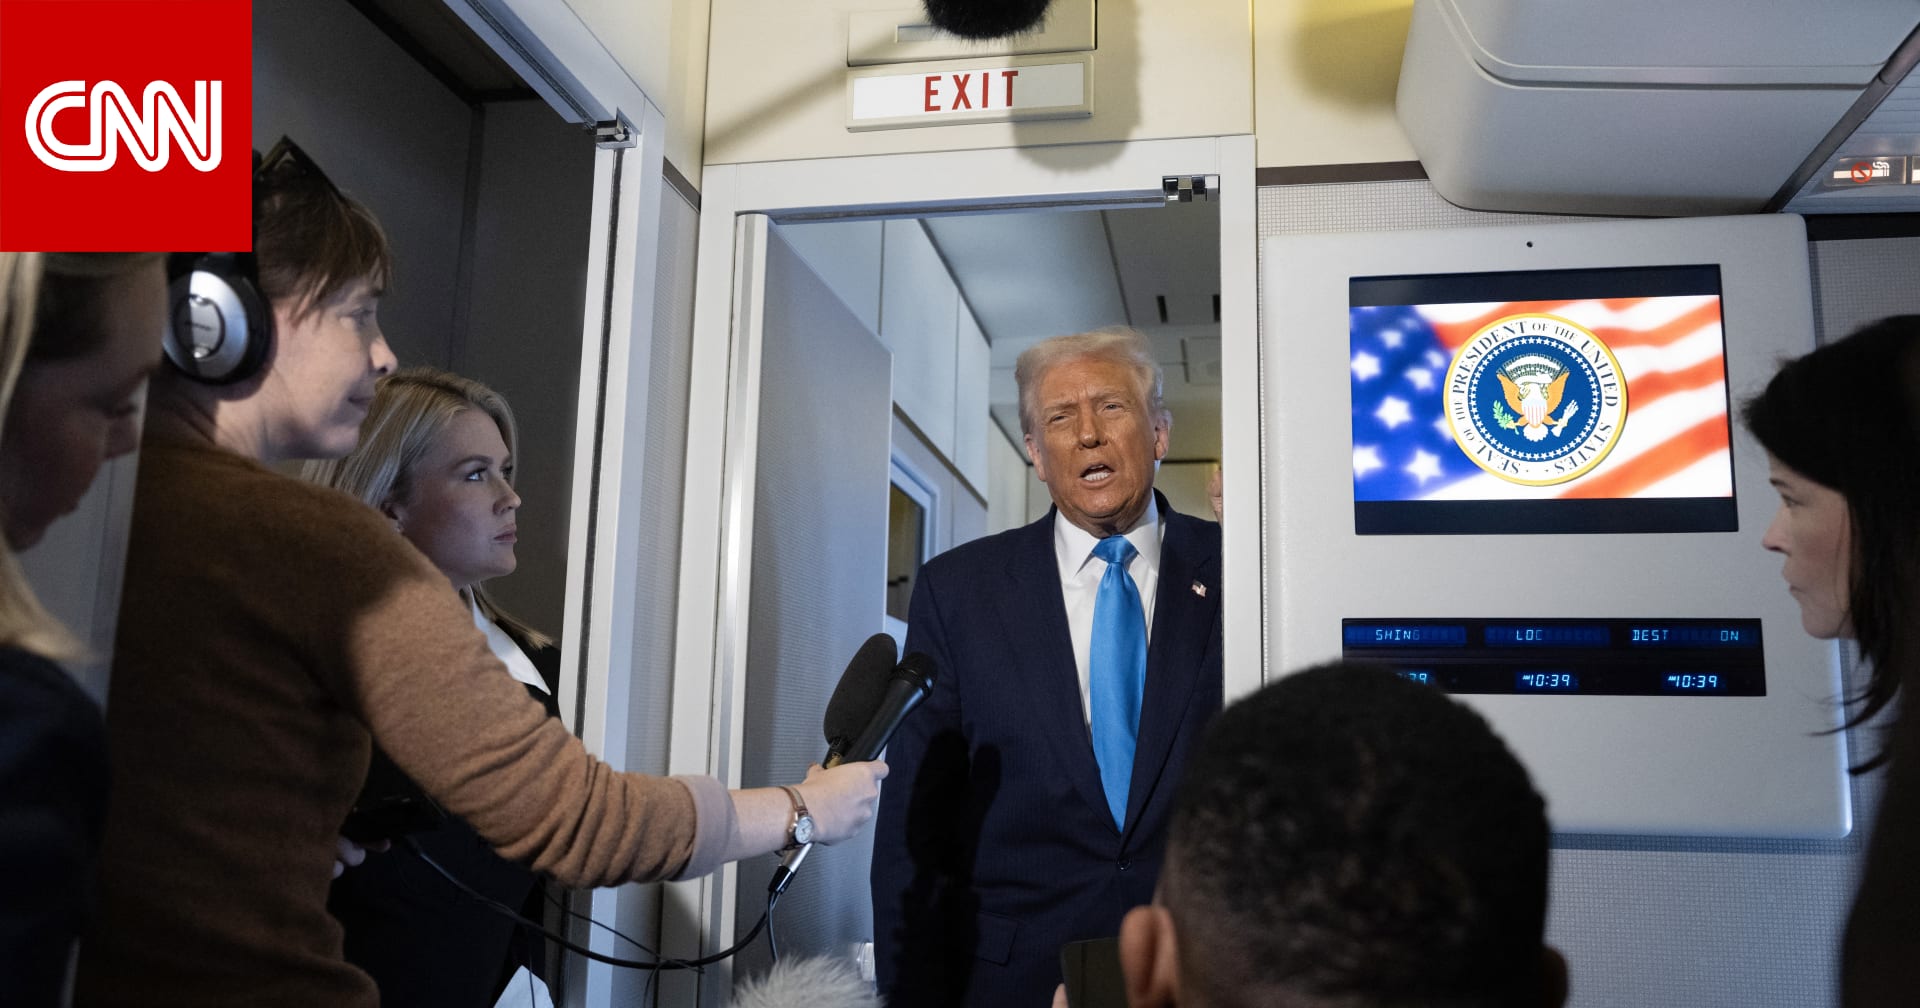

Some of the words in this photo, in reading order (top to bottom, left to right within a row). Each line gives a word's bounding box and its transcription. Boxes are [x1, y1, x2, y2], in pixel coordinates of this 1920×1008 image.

[924, 70, 1019, 112] EXIT
[1532, 322, 1549, 332] OF
[1554, 325, 1579, 341] THE
[1452, 320, 1528, 394] PRESIDENT
[1580, 339, 1618, 407] UNITED
[1476, 441, 1521, 474] SEAL
[1553, 421, 1613, 474] STATES
[1632, 629, 1669, 641] DEST
[1720, 630, 1739, 642] ON
[1530, 674, 1570, 687] 10:39
[1674, 675, 1718, 688] 10:39
